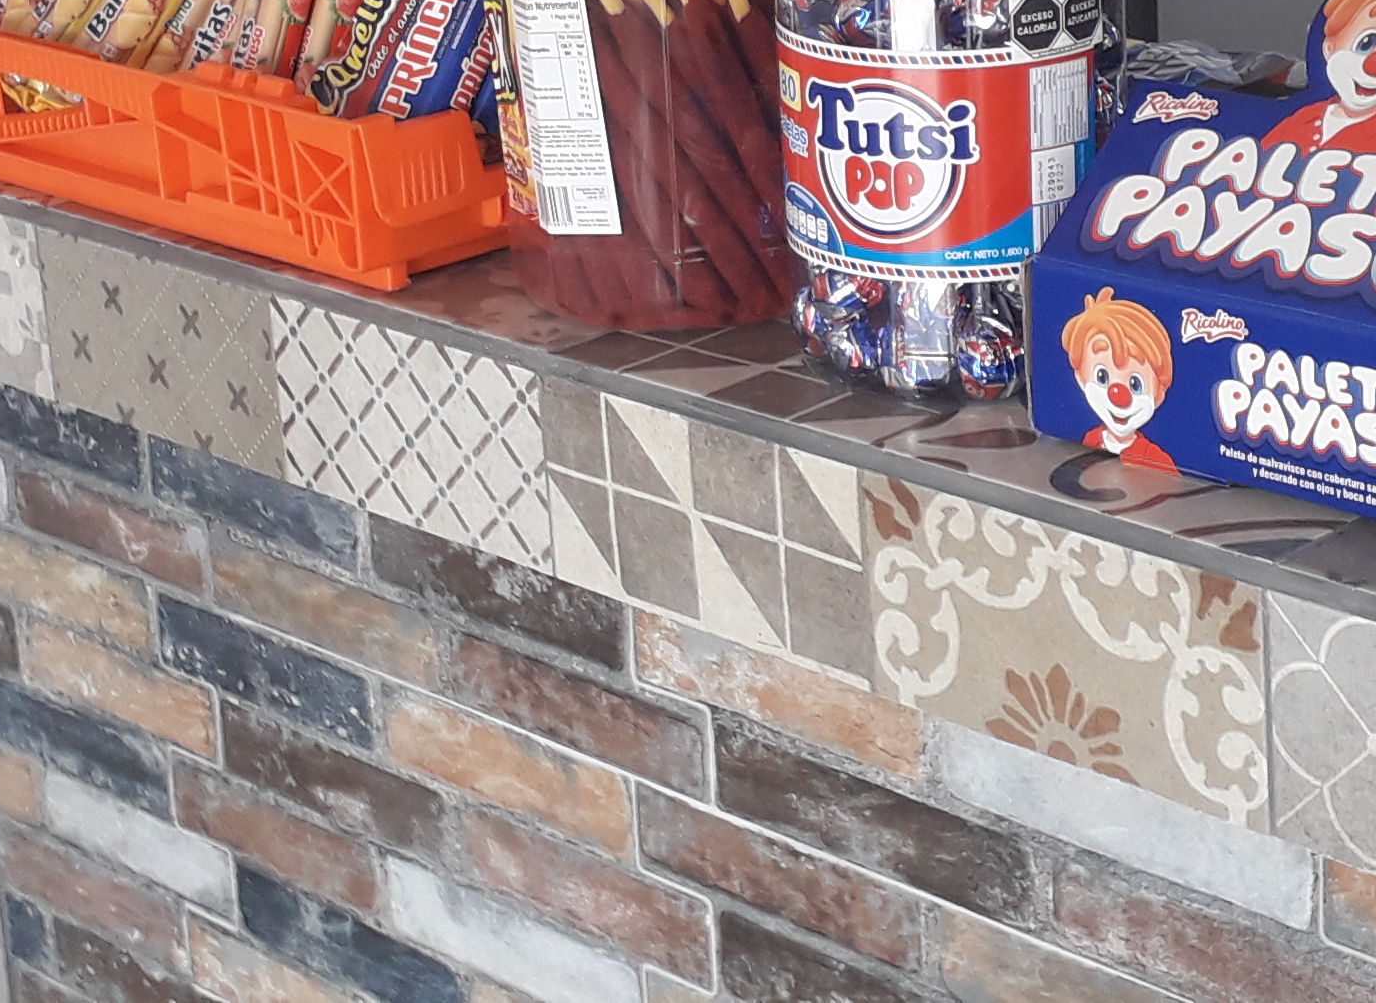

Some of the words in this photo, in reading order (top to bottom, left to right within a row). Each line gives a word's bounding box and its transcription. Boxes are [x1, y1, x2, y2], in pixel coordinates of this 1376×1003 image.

[1021, 10, 1054, 23] EXCESO
[1138, 93, 1216, 115] Ricolino
[809, 82, 974, 160] Tutsi
[845, 156, 925, 211] POP
[974, 248, 999, 259] NETO
[1184, 309, 1244, 331] Ricolino
[1220, 444, 1246, 462] Paleta
[1247, 453, 1258, 464] de
[1259, 456, 1306, 476] malvavisco
[1307, 468, 1323, 480] con
[1324, 472, 1365, 491] cobertura
[1252, 466, 1259, 478] y
[1259, 468, 1298, 487] decorado
[1299, 479, 1315, 491] con
[1316, 482, 1335, 496] ojos
[1335, 488, 1342, 499] y
[1342, 488, 1365, 503] boca
[1366, 494, 1376, 506] de
